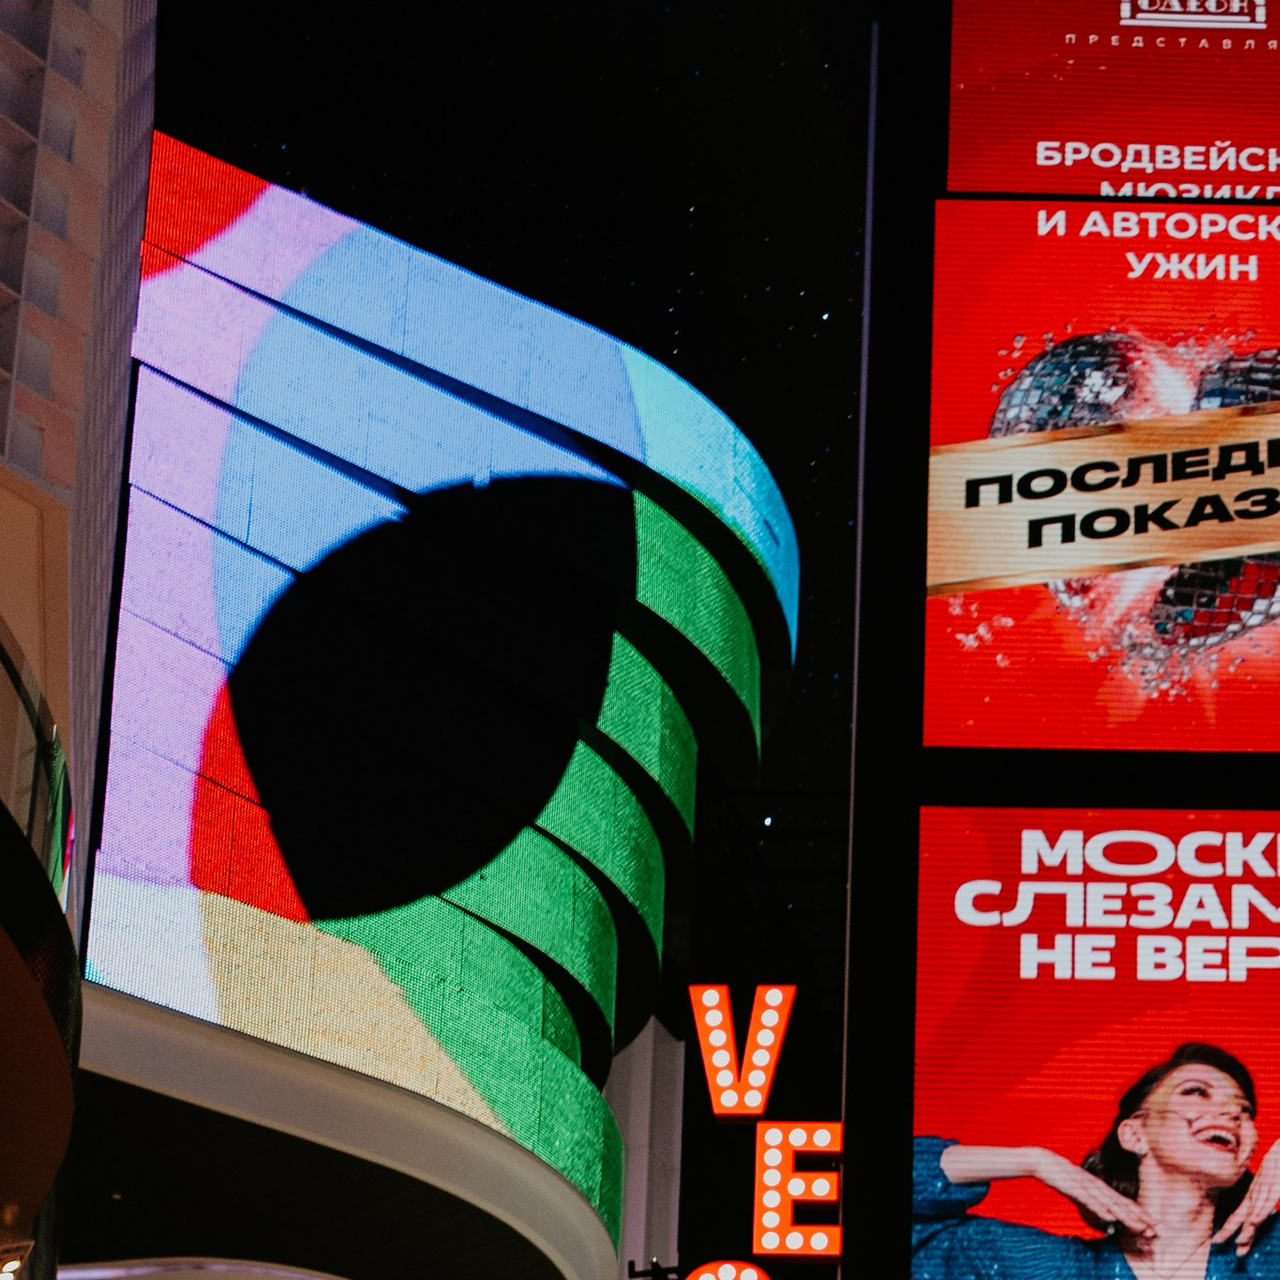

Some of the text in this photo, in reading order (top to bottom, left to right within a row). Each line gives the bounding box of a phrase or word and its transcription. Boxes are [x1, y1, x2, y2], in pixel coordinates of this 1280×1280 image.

[1037, 210, 1066, 237] И
[1125, 253, 1259, 281] УЖИН
[1020, 934, 1117, 980] НЕ
